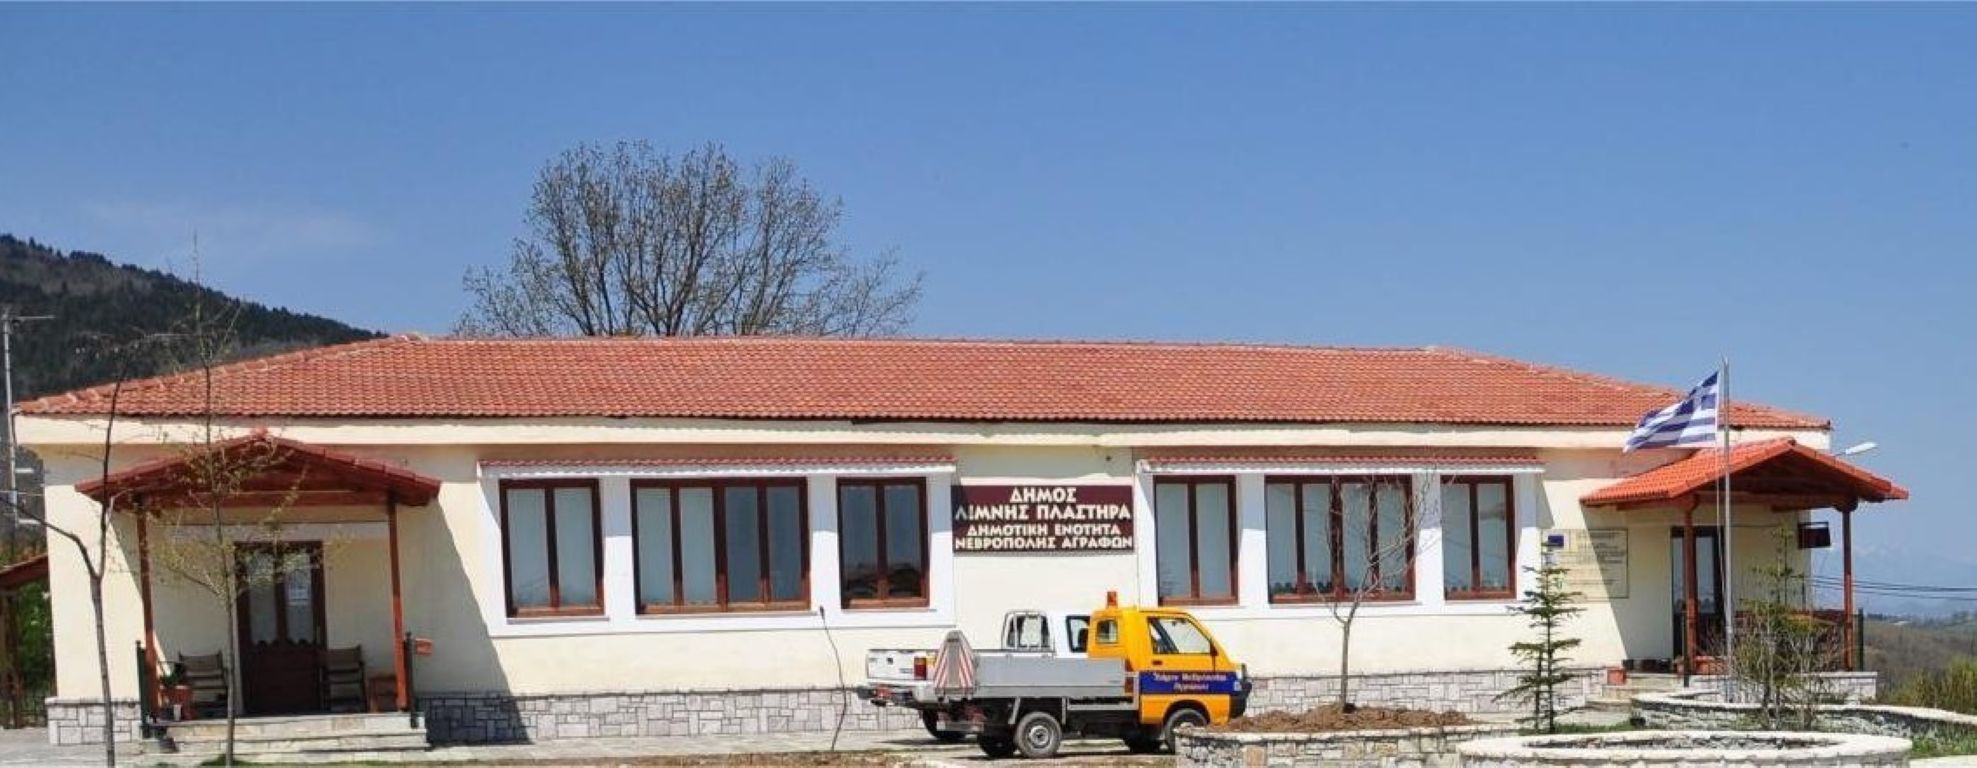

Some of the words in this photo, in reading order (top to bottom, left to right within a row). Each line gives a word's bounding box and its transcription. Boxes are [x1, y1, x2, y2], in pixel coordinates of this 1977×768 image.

[1009, 487, 1077, 503] ΔΗΜΟΣ
[955, 504, 1030, 520] ΛΙΜΝΗΣ
[1037, 503, 1131, 520] ΠΛΑΣΤΗΡΑ
[967, 524, 1048, 537] ΔΗΜΟΤΙΚΗ
[1054, 523, 1121, 536] ΕΝΟΤΗΤΑ
[955, 536, 1056, 549] ΝΕΒΡΟΠΟΛΗΣ
[1061, 536, 1132, 549] ΑΓΡΑΦΩΝ
